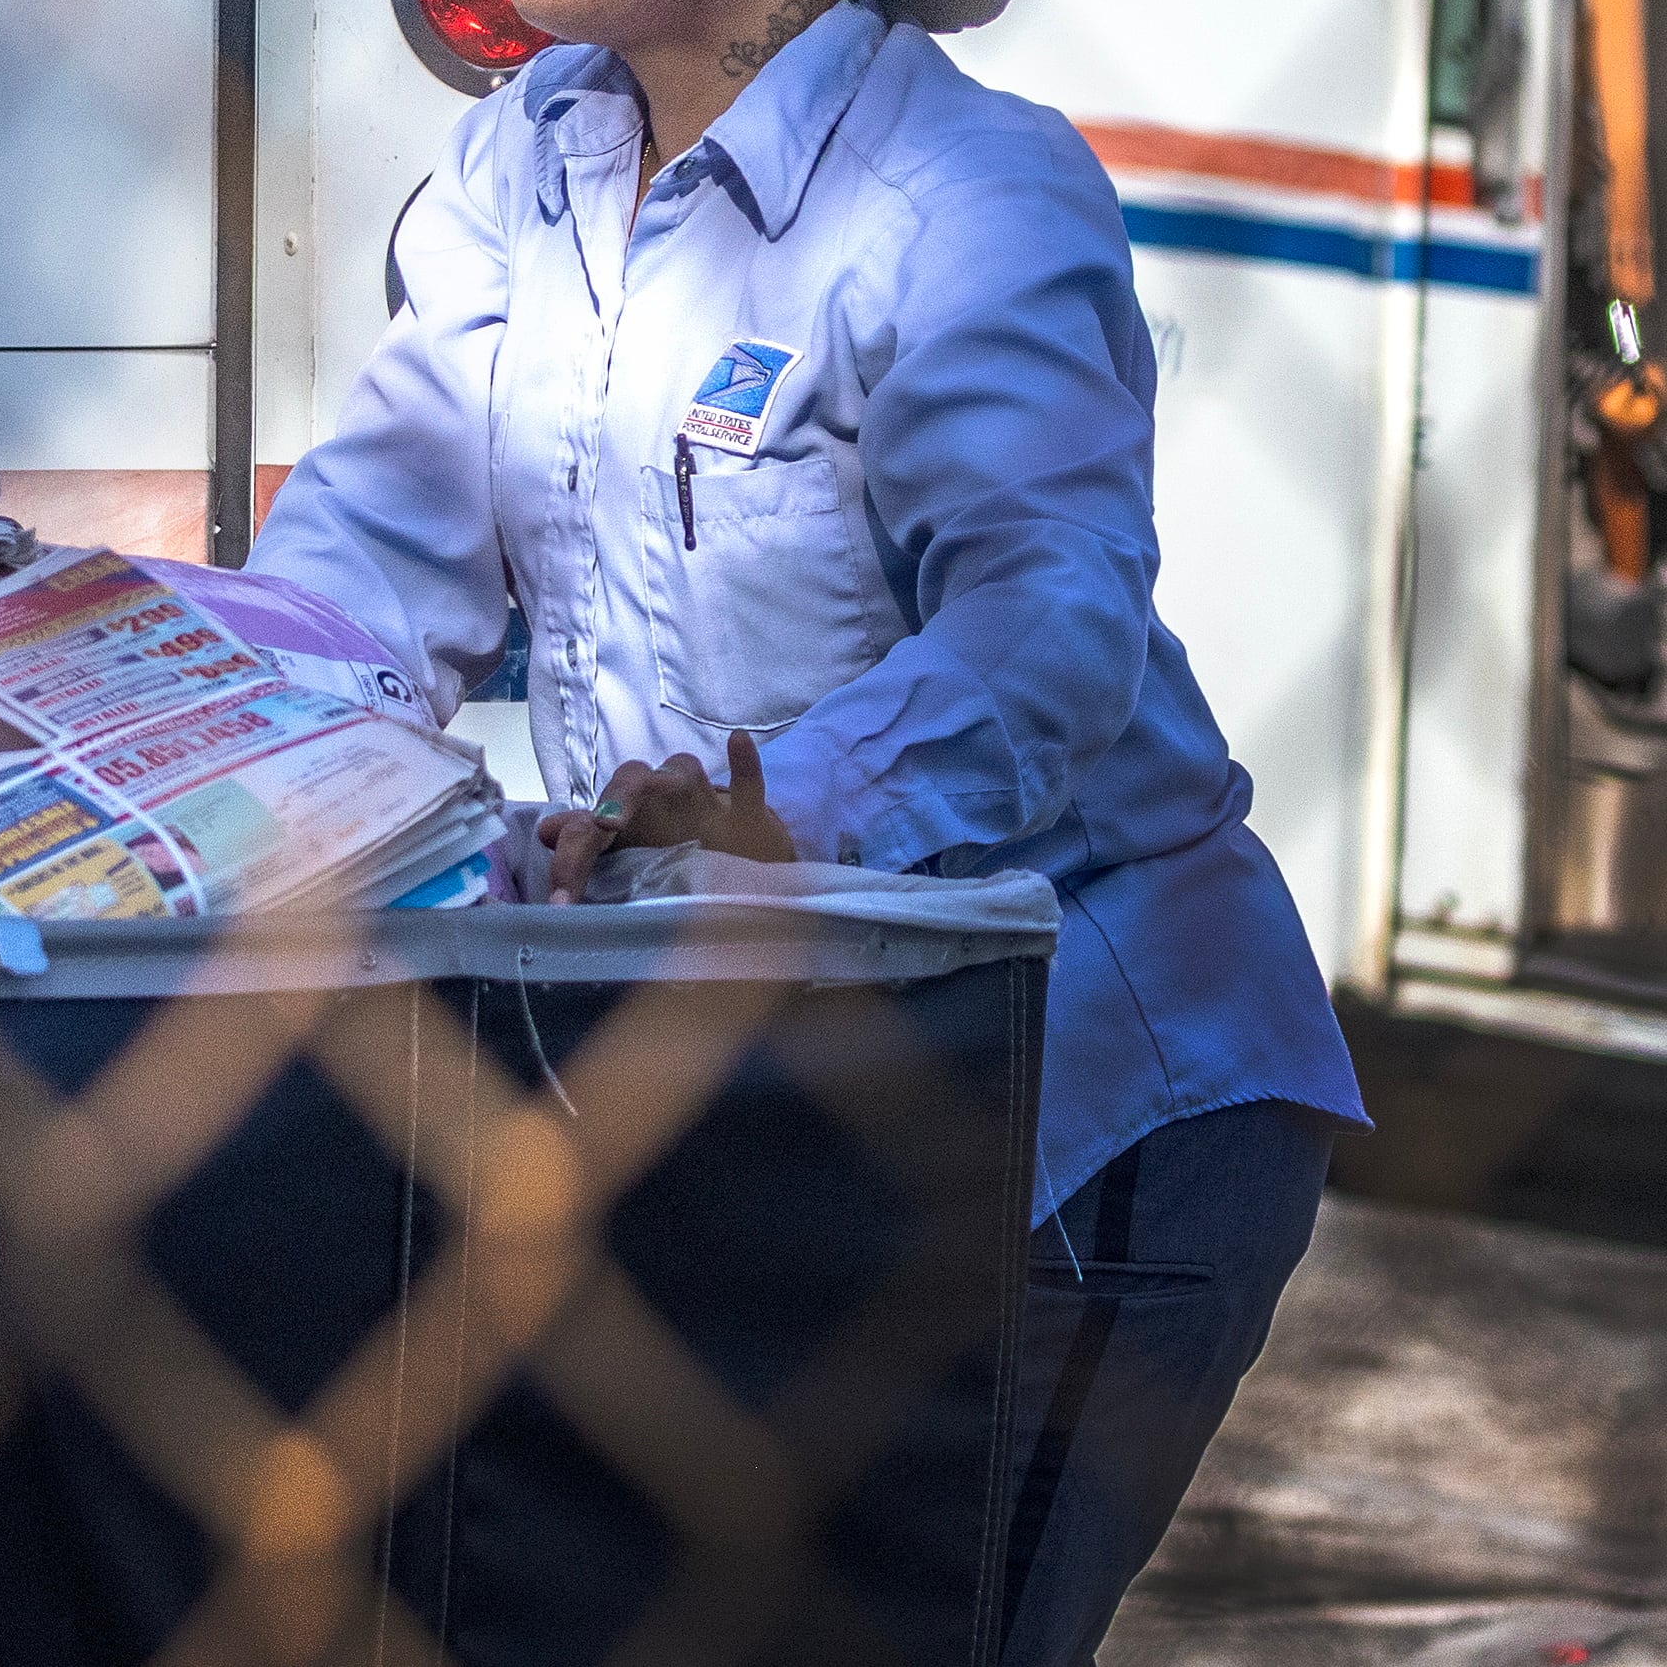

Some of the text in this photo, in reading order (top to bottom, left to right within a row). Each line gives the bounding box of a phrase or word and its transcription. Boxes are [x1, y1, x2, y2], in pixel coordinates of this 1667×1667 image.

[688, 408, 752, 430] UNITED STATES
[682, 421, 752, 446] POSTAL SERVICE
[376, 669, 413, 704] G
